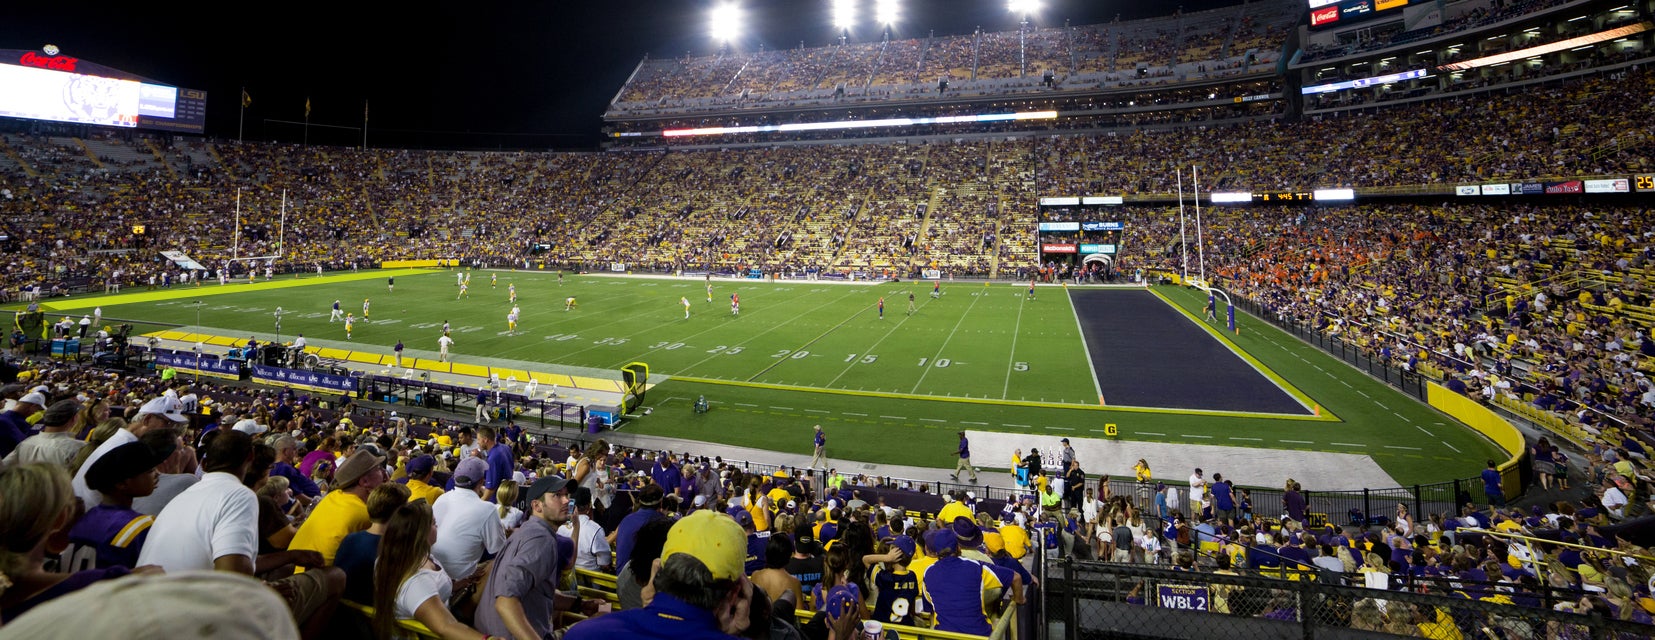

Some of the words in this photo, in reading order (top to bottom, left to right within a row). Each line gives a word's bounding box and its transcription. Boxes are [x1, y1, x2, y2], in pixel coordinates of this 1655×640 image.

[180, 91, 204, 100] LSU
[1637, 176, 1654, 189] 25
[648, 341, 686, 350] 30
[706, 345, 746, 355] 25
[771, 349, 810, 359] 20
[844, 353, 878, 364] 15
[918, 357, 951, 368] 10
[1014, 361, 1030, 372] 5
[1108, 426, 1116, 434] G
[1161, 595, 1195, 610] WBL
[1197, 596, 1207, 611] 2
[889, 597, 910, 623] 9
